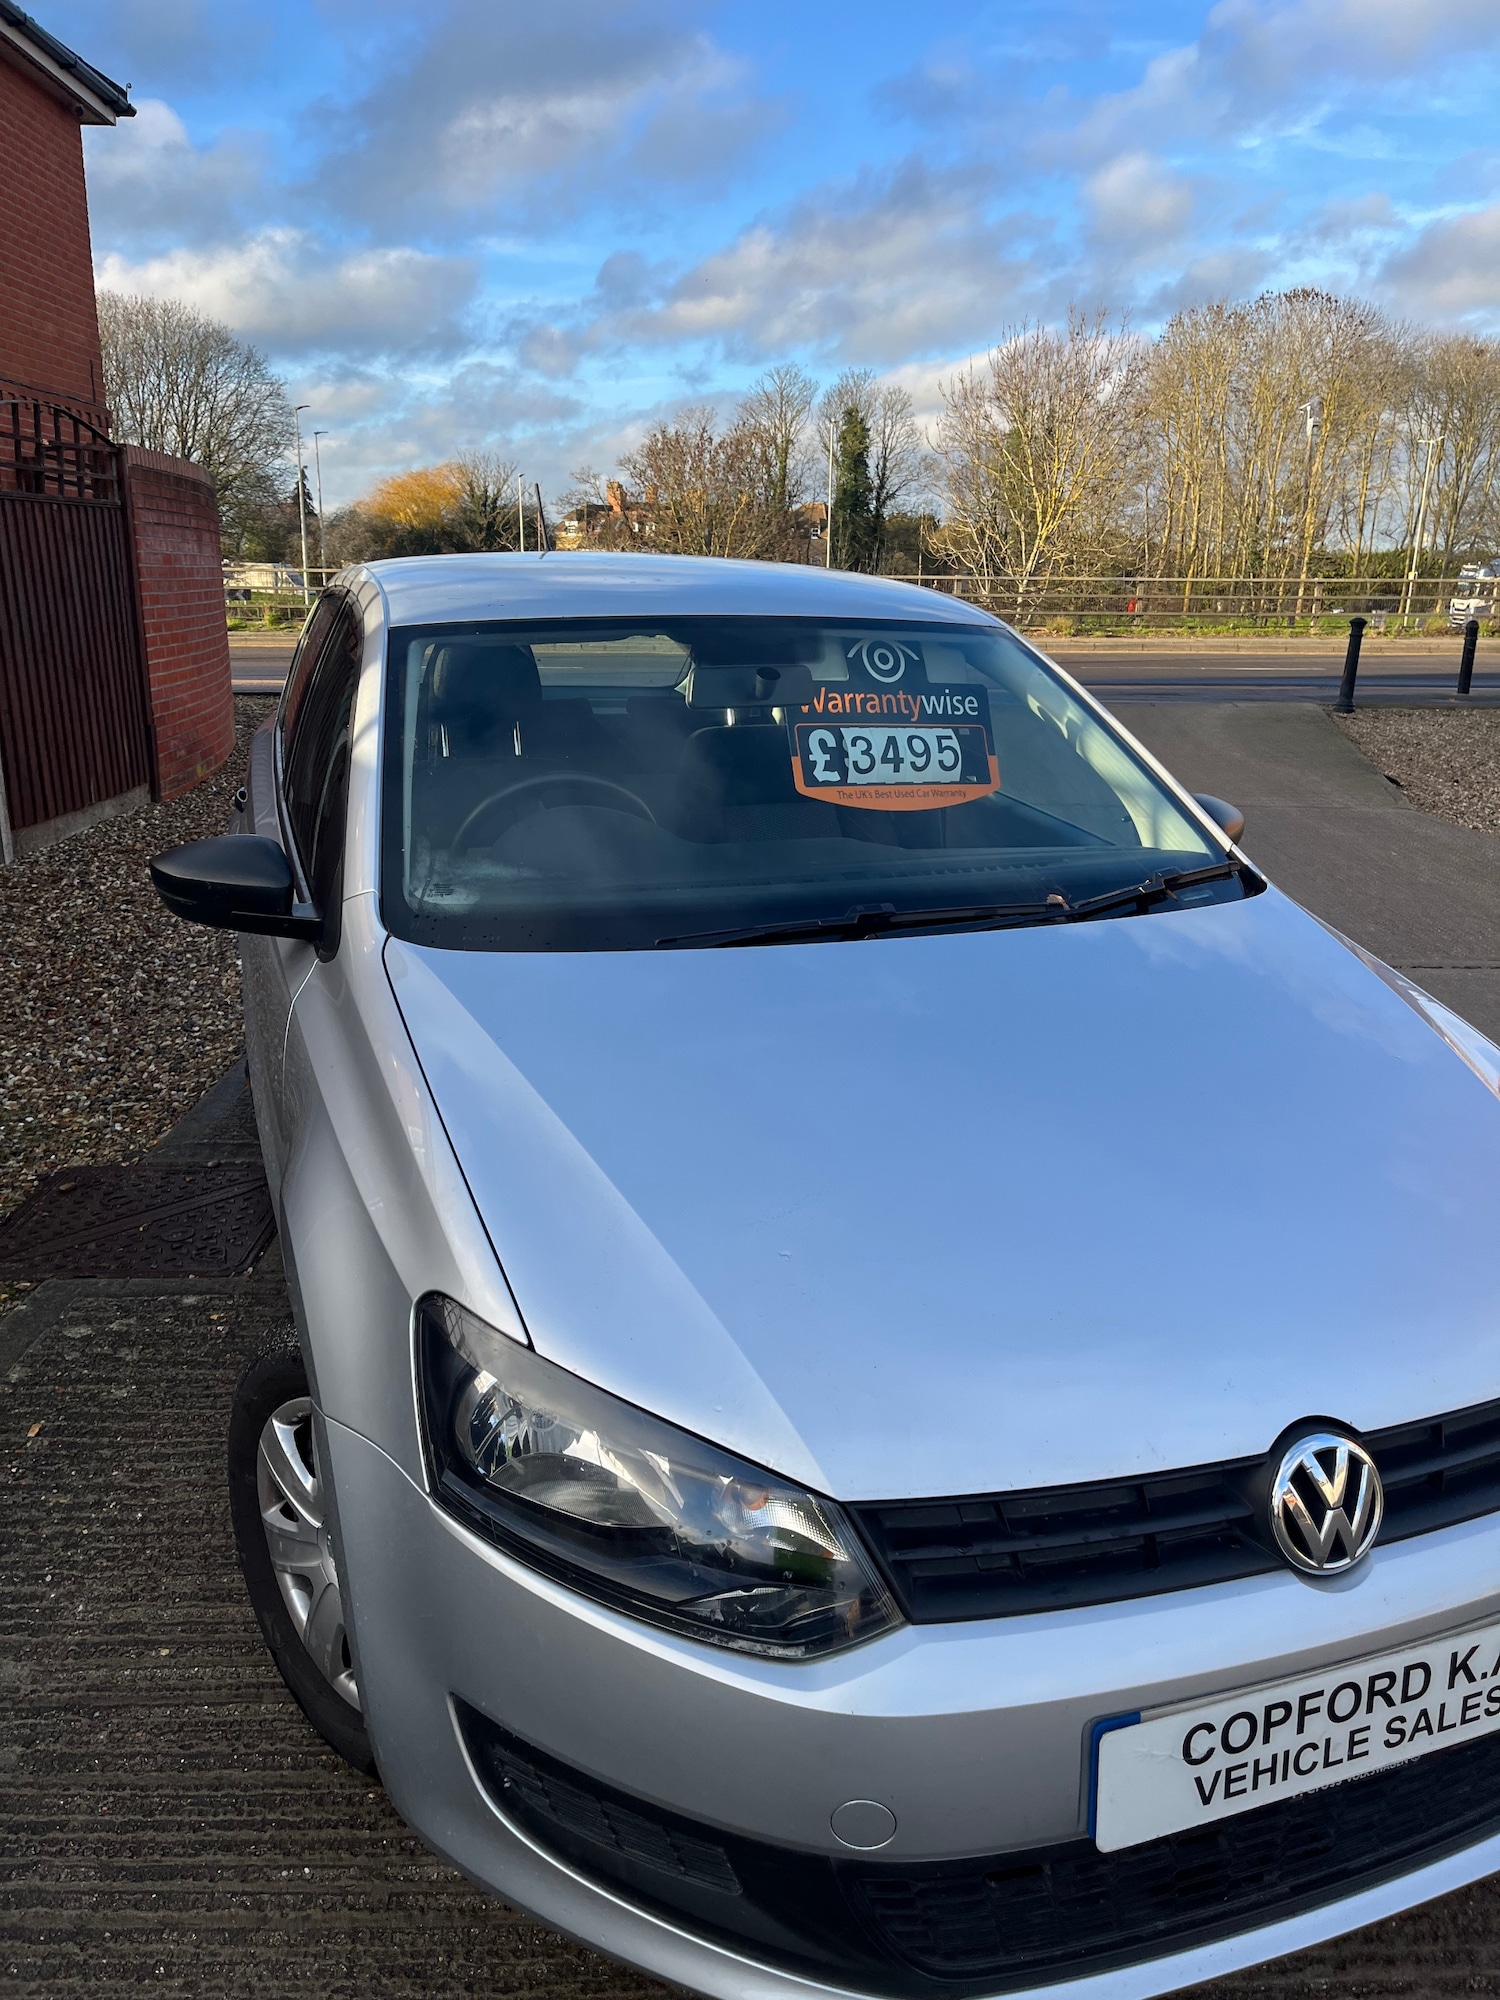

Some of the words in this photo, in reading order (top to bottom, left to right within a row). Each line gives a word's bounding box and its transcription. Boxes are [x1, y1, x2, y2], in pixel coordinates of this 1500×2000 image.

[801, 687, 979, 722] Warrantywise
[808, 729, 960, 783] £3495
[836, 790, 853, 799] The
[855, 790, 873, 799] UK's
[875, 789, 893, 799] Best
[894, 789, 915, 799] Used
[916, 789, 930, 798] Car
[931, 788, 967, 799] Warranty
[1182, 1660, 1432, 1766] COPFORD
[1447, 1644, 1500, 1690] K.
[1194, 1725, 1371, 1806] VEHICLE
[1383, 1684, 1500, 1747] SALES
